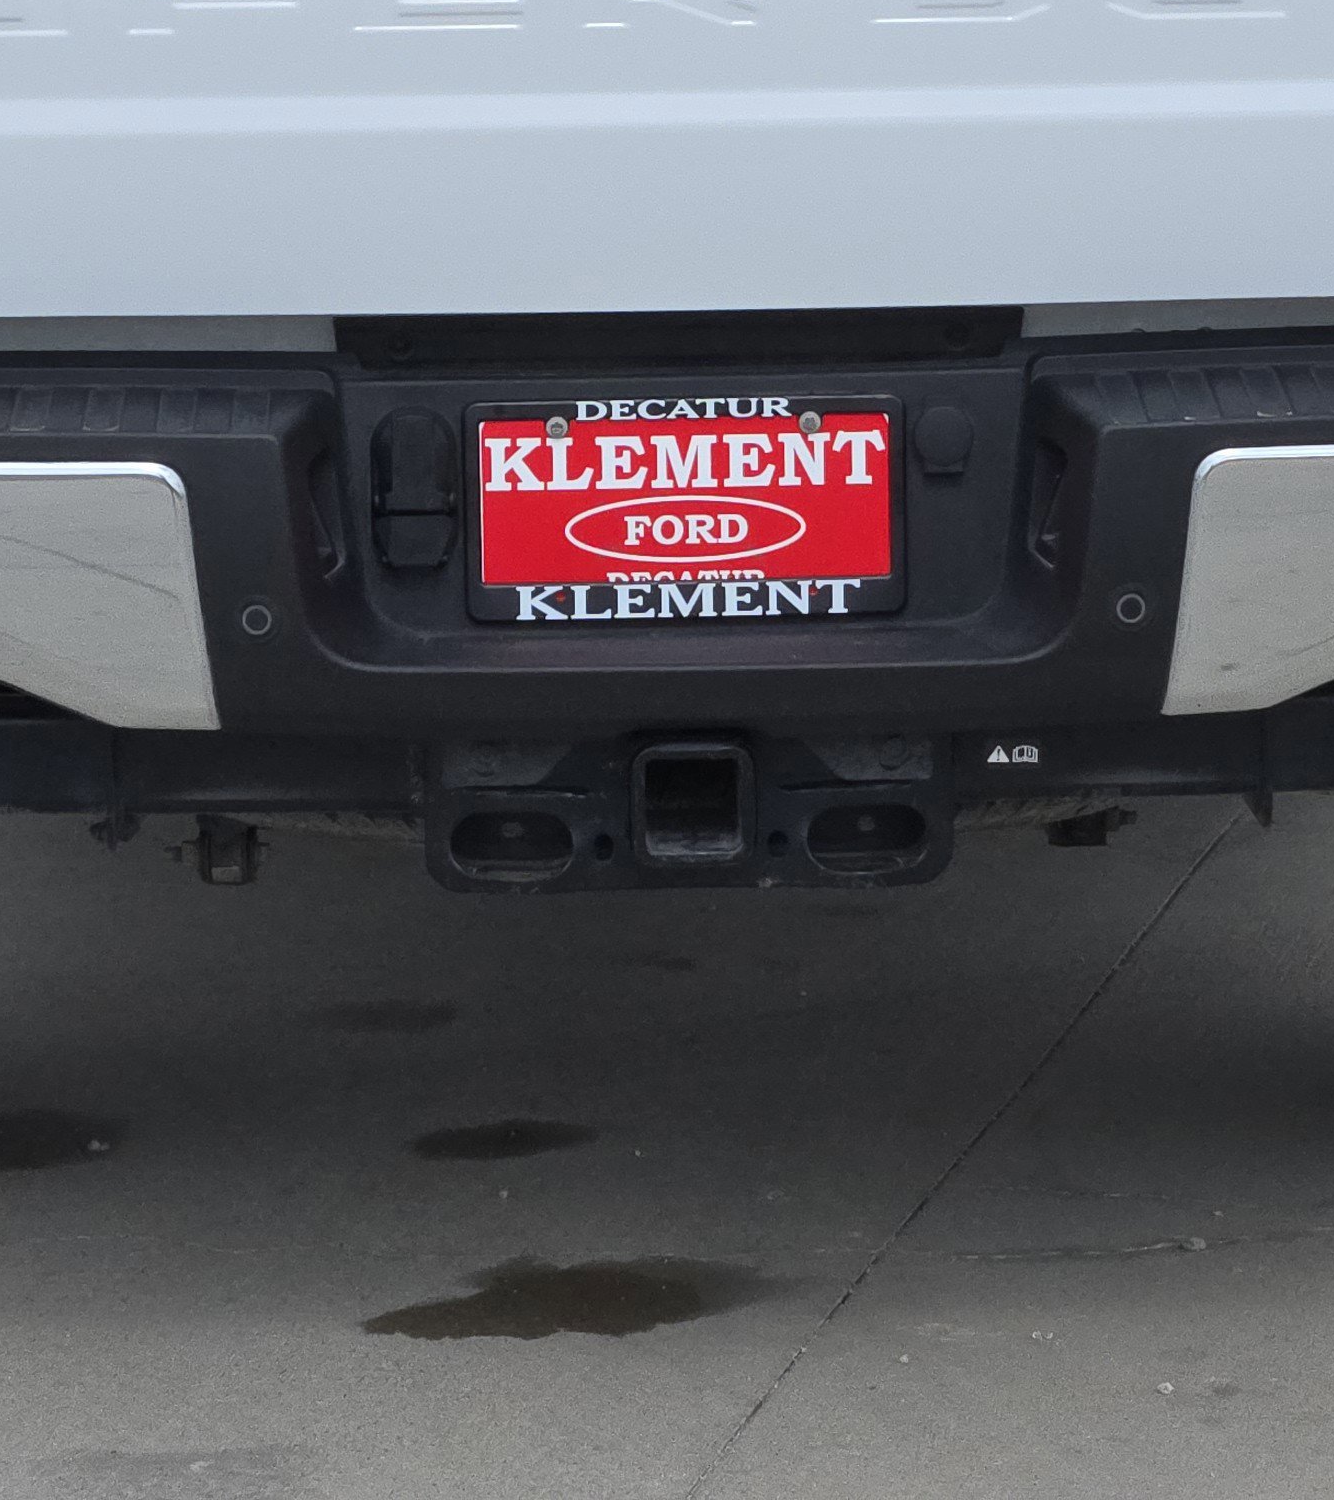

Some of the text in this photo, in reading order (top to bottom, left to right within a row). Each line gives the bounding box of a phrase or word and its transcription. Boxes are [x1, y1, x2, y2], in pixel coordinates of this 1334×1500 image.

[576, 398, 793, 421] DECATUR
[484, 430, 886, 492] KLEMENT
[623, 514, 749, 546] FORD
[516, 579, 861, 621] KLEMENT
